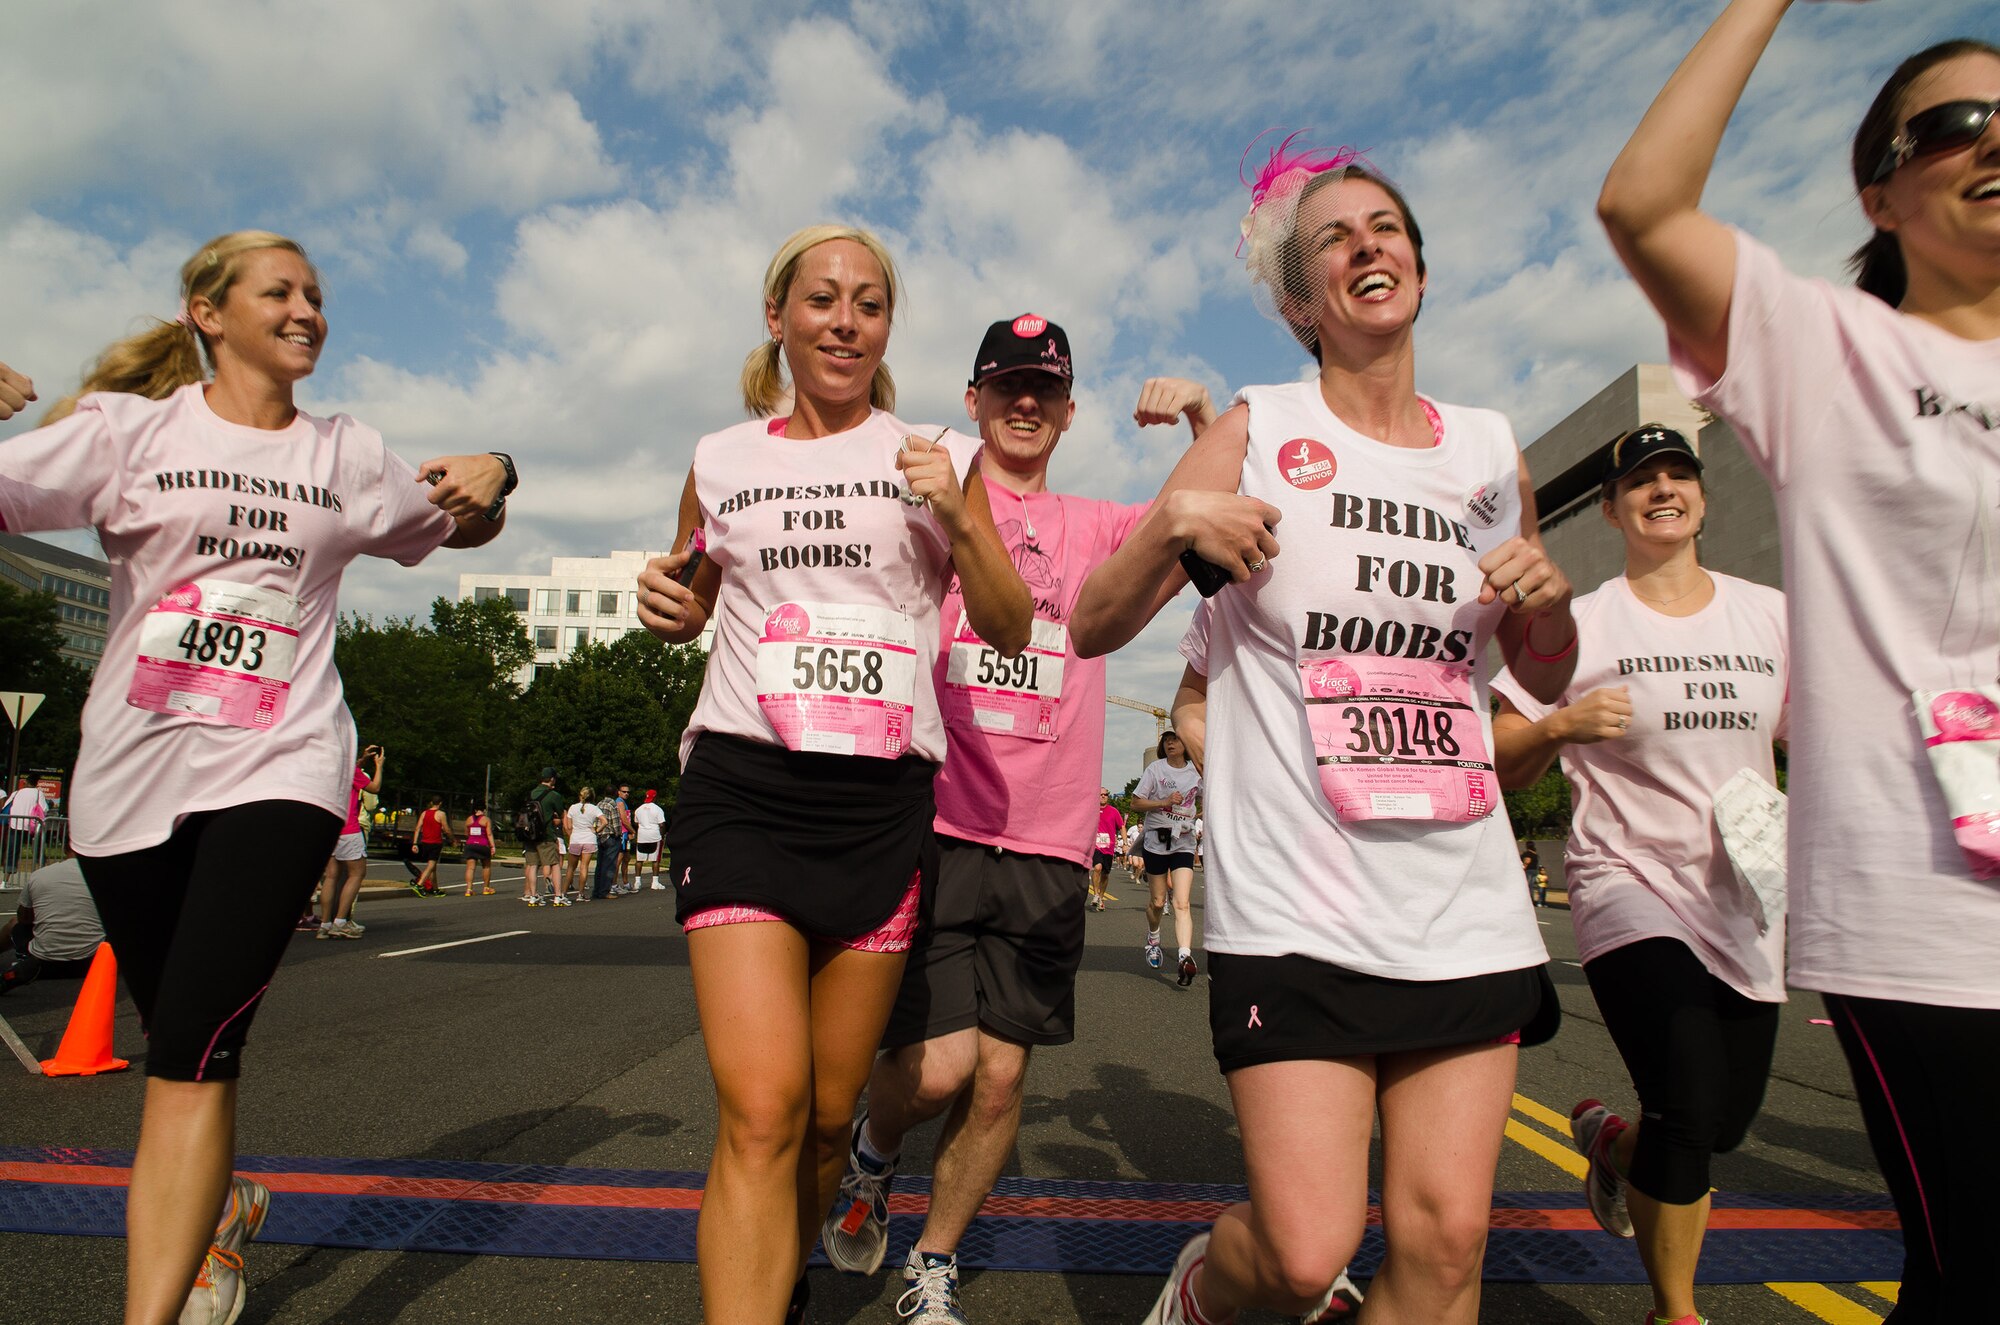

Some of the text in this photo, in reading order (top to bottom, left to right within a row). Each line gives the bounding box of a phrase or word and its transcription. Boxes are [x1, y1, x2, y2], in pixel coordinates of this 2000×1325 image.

[1291, 470, 1333, 486] SURVIVOR
[1312, 461, 1329, 471] YEAR
[155, 469, 342, 513] BRIDESMAIDS
[717, 480, 910, 517] BRIDESMAID
[228, 504, 289, 532] FOR
[783, 509, 846, 531] FOR
[1330, 492, 1477, 553] BRIDE
[196, 535, 306, 570] BOOBS!
[759, 544, 872, 572] BOOBS!
[1355, 554, 1457, 605] FOR
[178, 618, 267, 671] 4893
[792, 645, 884, 695] 5658
[976, 648, 1039, 691] 5591
[1617, 654, 1774, 677] BRIDESMAIDS
[1327, 679, 1348, 687] race
[1683, 681, 1737, 700] FOR
[882, 701, 906, 711] POLITICO
[1341, 706, 1461, 757] 30148
[1663, 711, 1757, 731] BOOBS!
[1457, 761, 1485, 769] POLITICO
[709, 911, 725, 927] go
